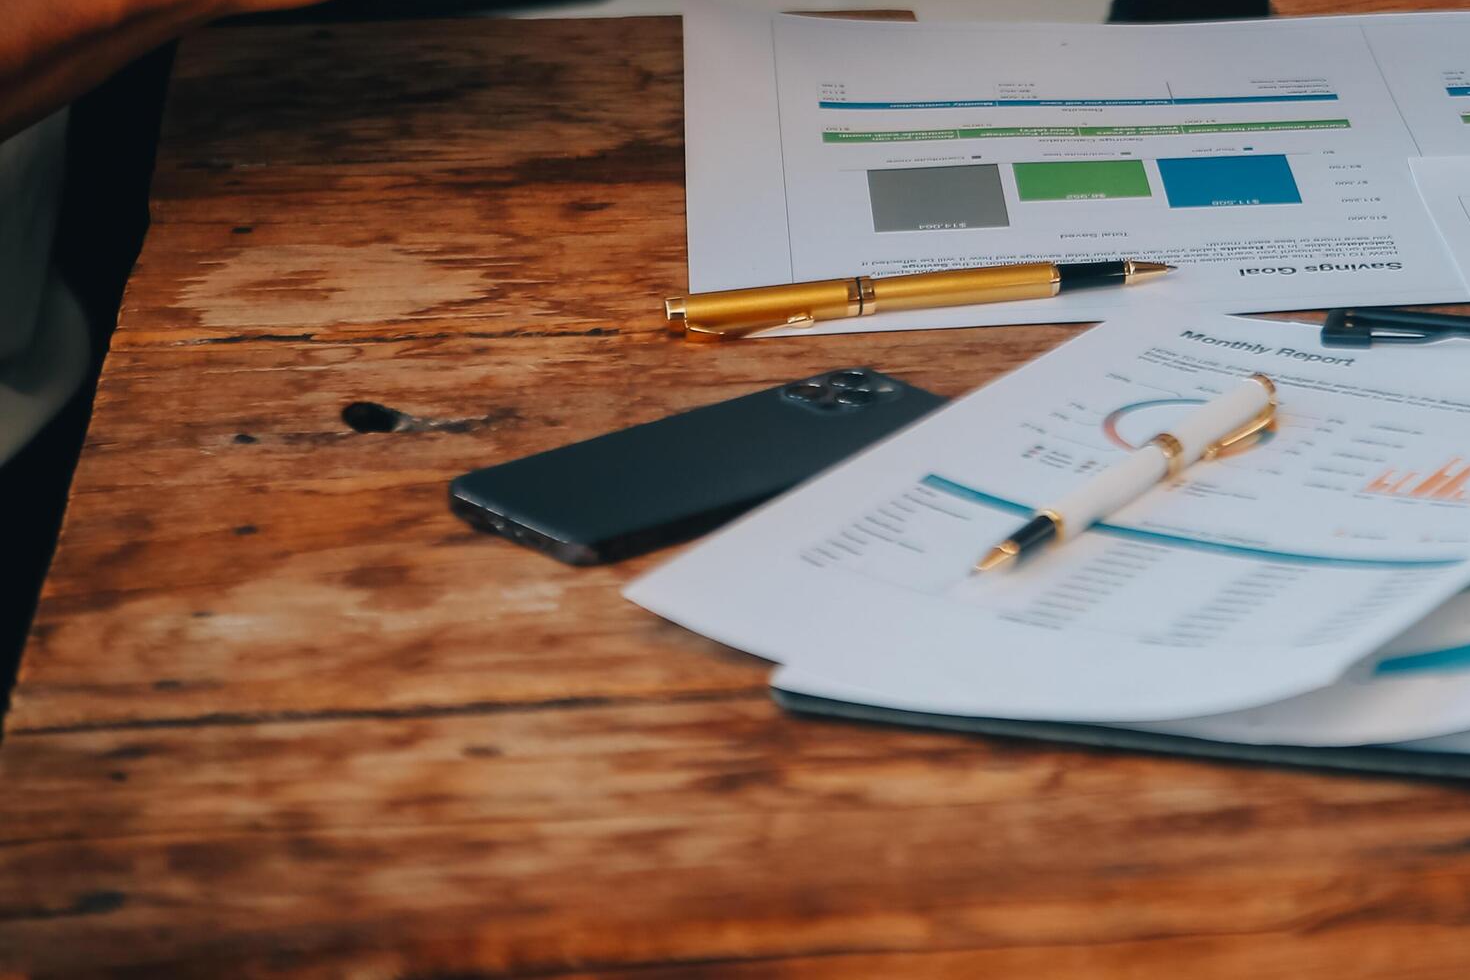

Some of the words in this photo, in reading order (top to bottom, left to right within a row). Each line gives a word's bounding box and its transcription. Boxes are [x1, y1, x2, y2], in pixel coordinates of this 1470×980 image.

[1239, 267, 1298, 277] Goal
[1303, 262, 1403, 273] Savings
[1178, 328, 1273, 356] Monthly
[1274, 345, 1357, 368] Report
